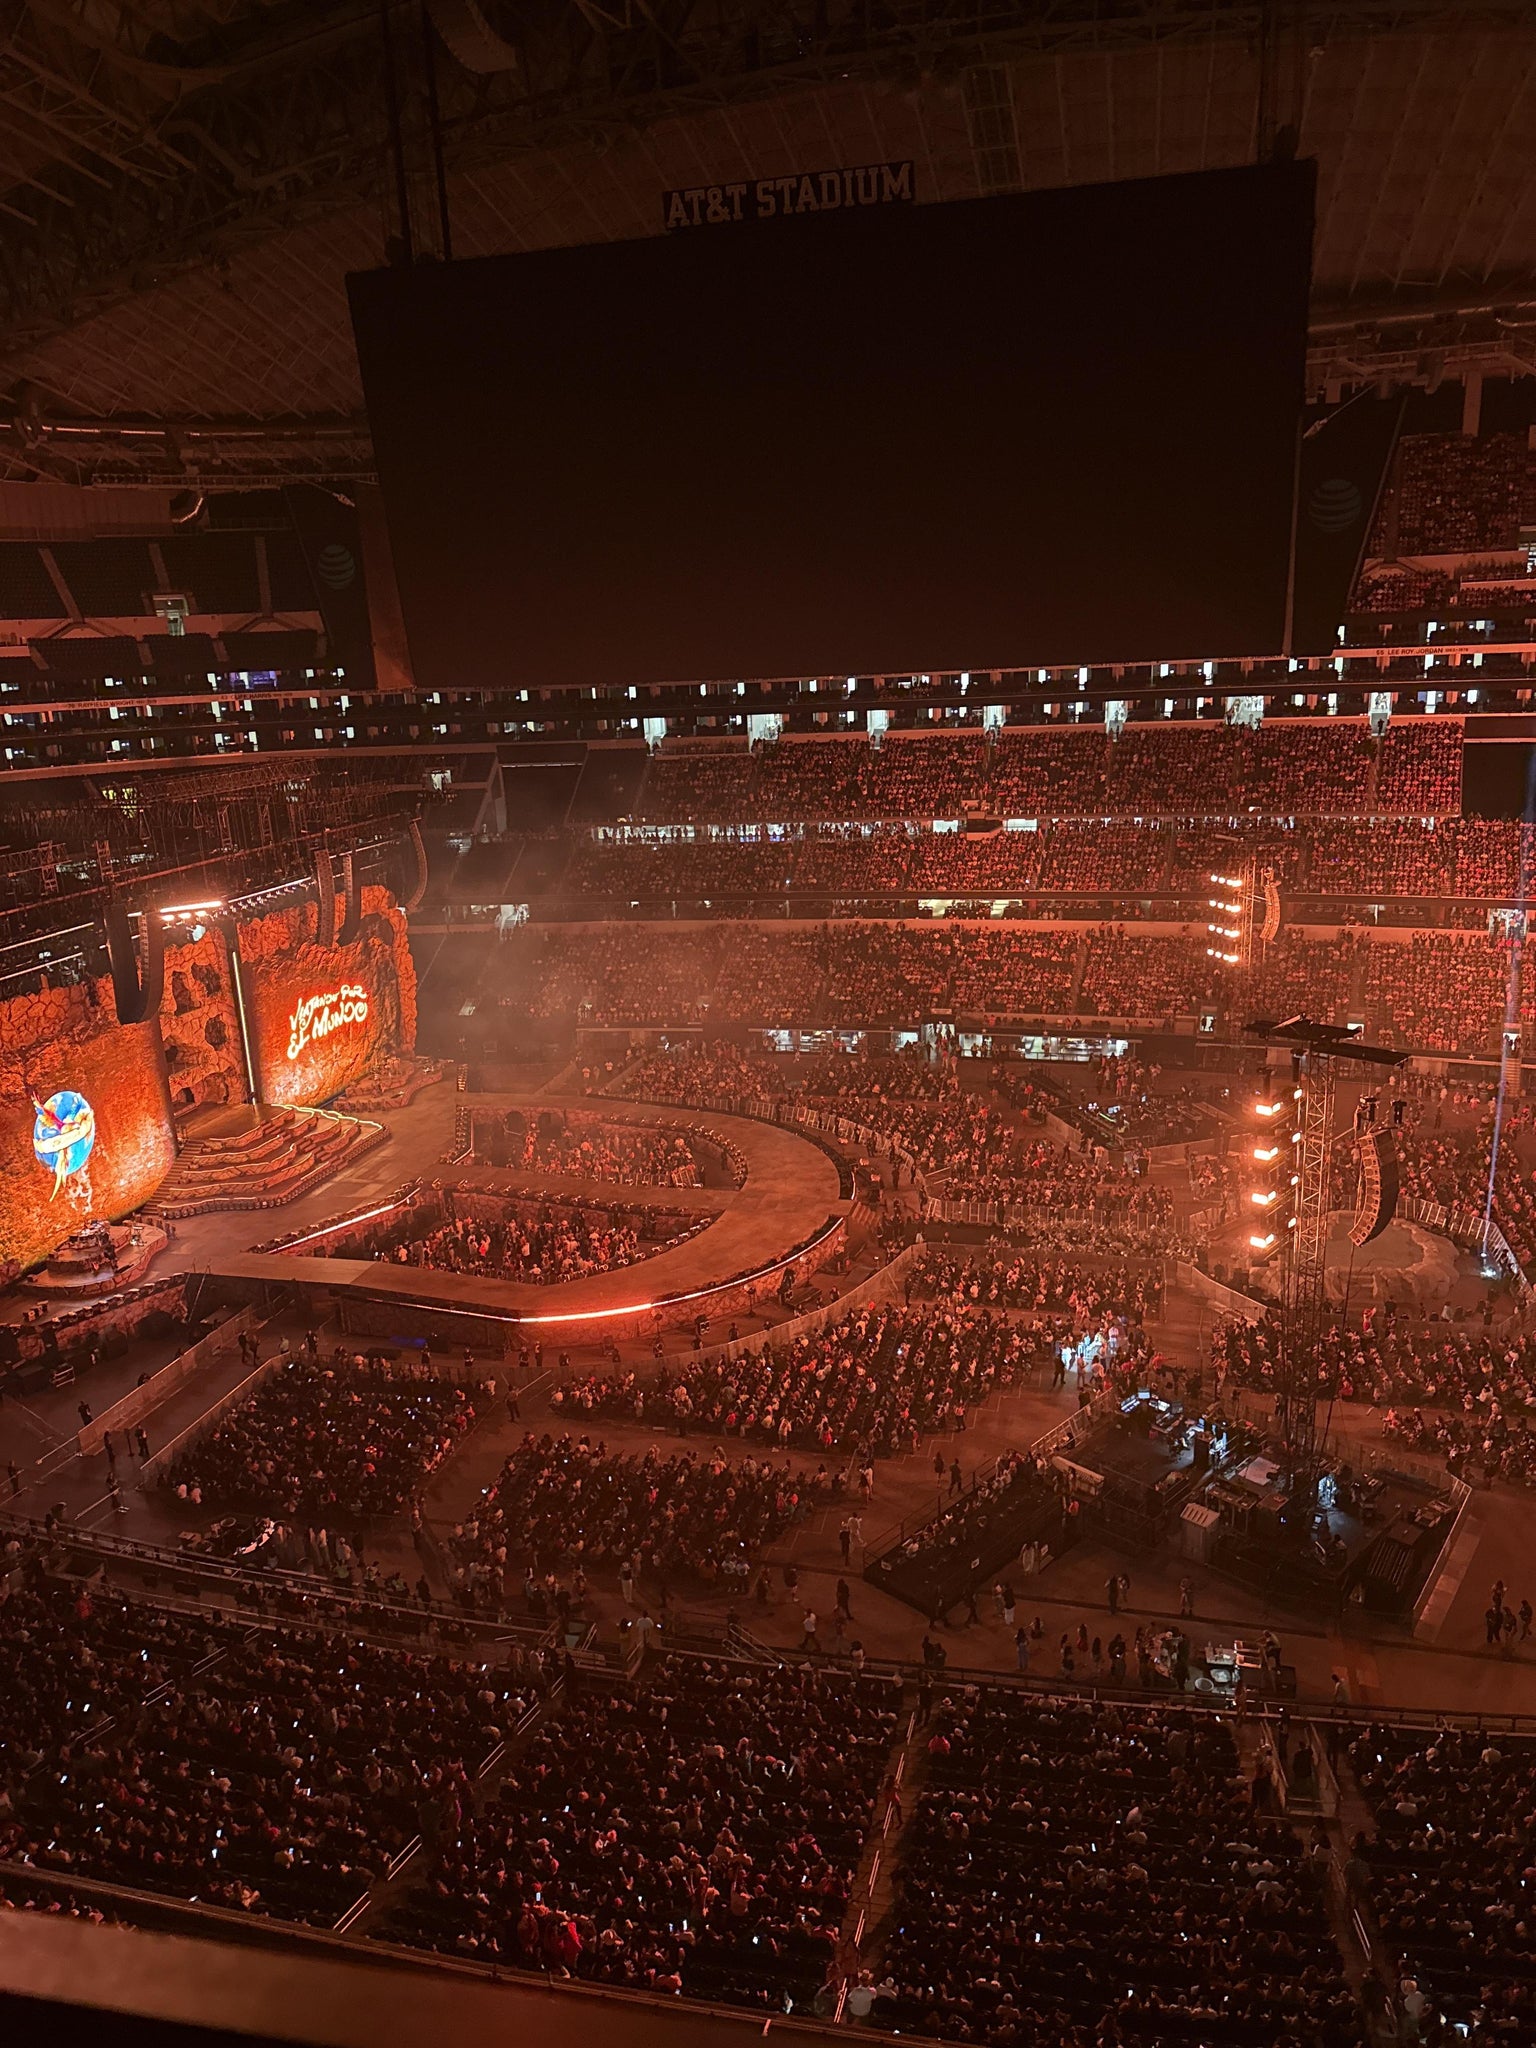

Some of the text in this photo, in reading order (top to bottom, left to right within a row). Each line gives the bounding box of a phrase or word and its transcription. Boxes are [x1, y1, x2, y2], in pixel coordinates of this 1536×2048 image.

[667, 163, 912, 229] AT&T STADIUM
[312, 1001, 368, 1039] MUNDO
